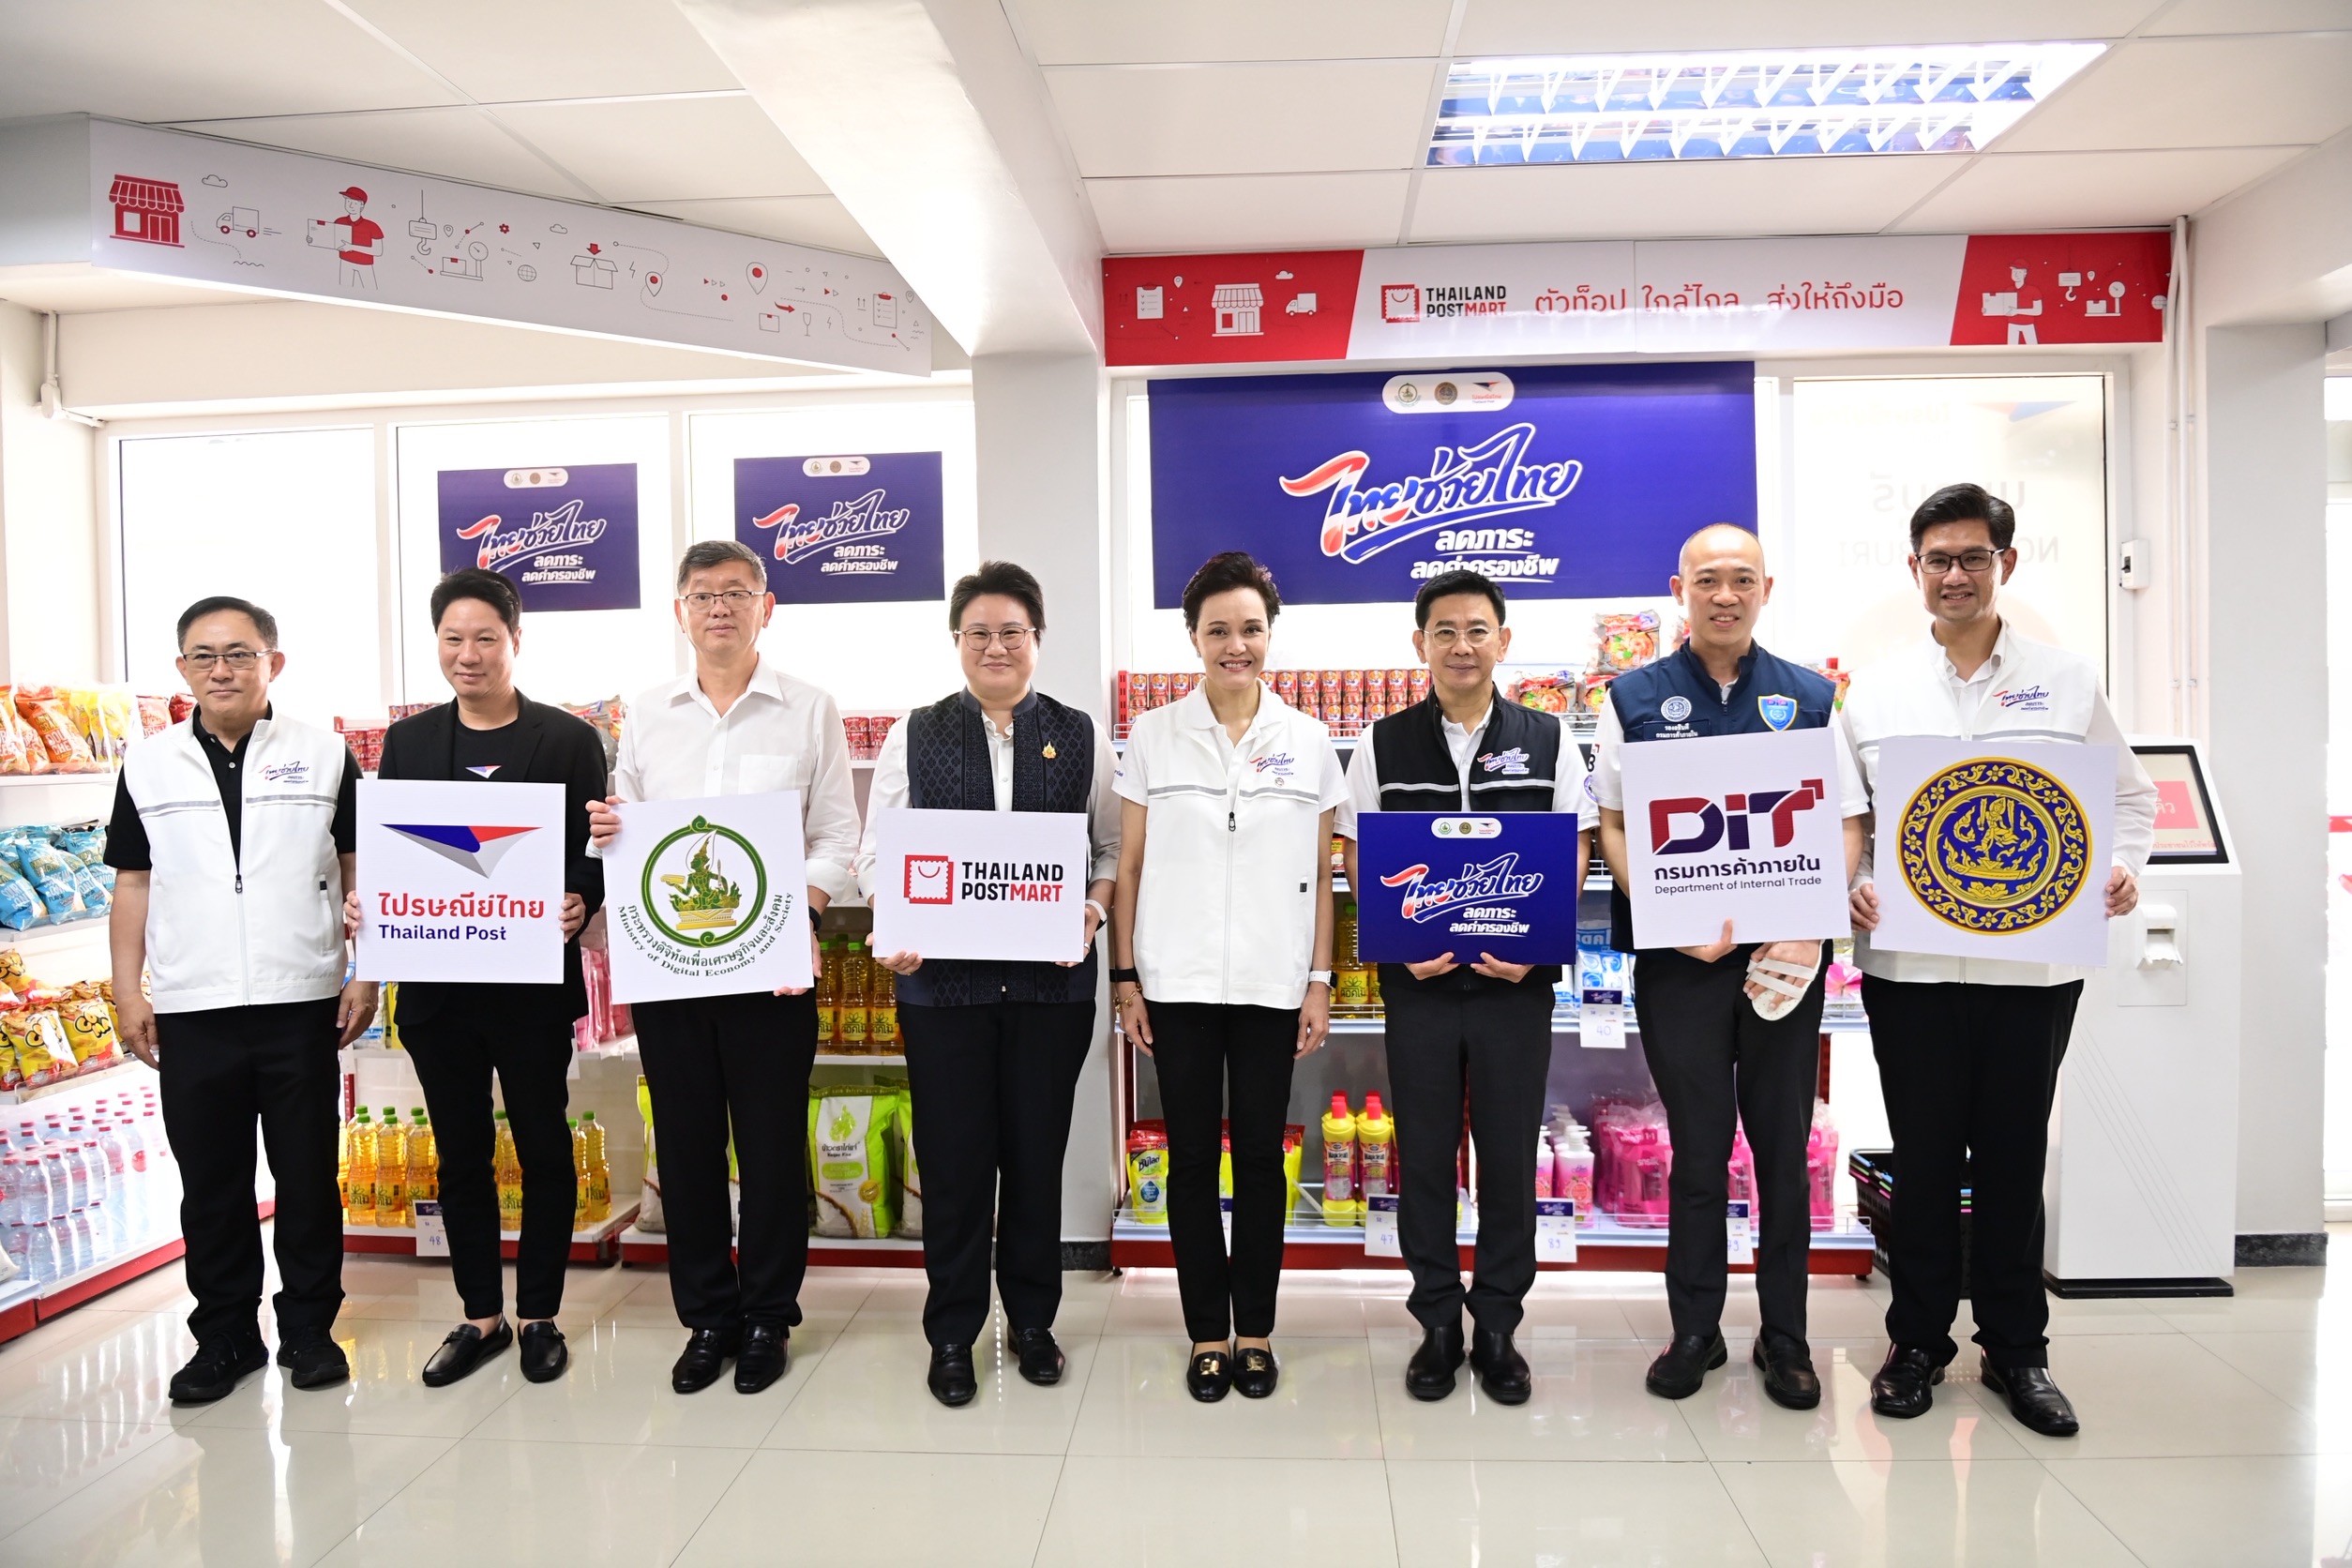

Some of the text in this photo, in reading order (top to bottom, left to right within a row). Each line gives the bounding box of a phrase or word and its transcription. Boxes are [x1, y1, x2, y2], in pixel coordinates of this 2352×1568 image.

[1425, 285, 1506, 302] THAILAND
[1535, 281, 1904, 314] ตัวท็อป ใกล้ไกล ส่งให้ถึงมือ
[1425, 302, 1506, 317] POSTMART
[1279, 422, 1582, 557] ไทยช่วยไทย
[456, 499, 607, 568] ไทยช่วยไทย
[753, 489, 911, 564] ไทยช่วยไทย
[1435, 526, 1534, 551] ลดภาระ
[534, 553, 583, 567] ลดภาระ
[833, 544, 885, 559] ลดภาระ
[521, 568, 596, 583] ลดค่าครองชีพ
[821, 558, 898, 574] ลดค่าครองชีพ
[962, 862, 1063, 882] THAILAND
[1654, 854, 1821, 881] กรมการค้าภายใน
[962, 882, 1063, 902] POSTMART
[1380, 852, 1544, 920] ไทยช่วยไทย
[1654, 876, 1822, 896] Department of Internal Trade
[379, 893, 544, 918] ไปรษณีย์ไทย
[1463, 906, 1517, 919] ลดภาระ
[379, 925, 506, 941] Thailand Post
[617, 892, 793, 977] Ministry of Digital Economy and Society
[628, 895, 782, 968] กระทรวงดิจิทัลเพื่อเศรษฐกิจและสังคม
[1449, 921, 1530, 934] ลดค่าครองชีพ
[430, 1236, 441, 1245] 48
